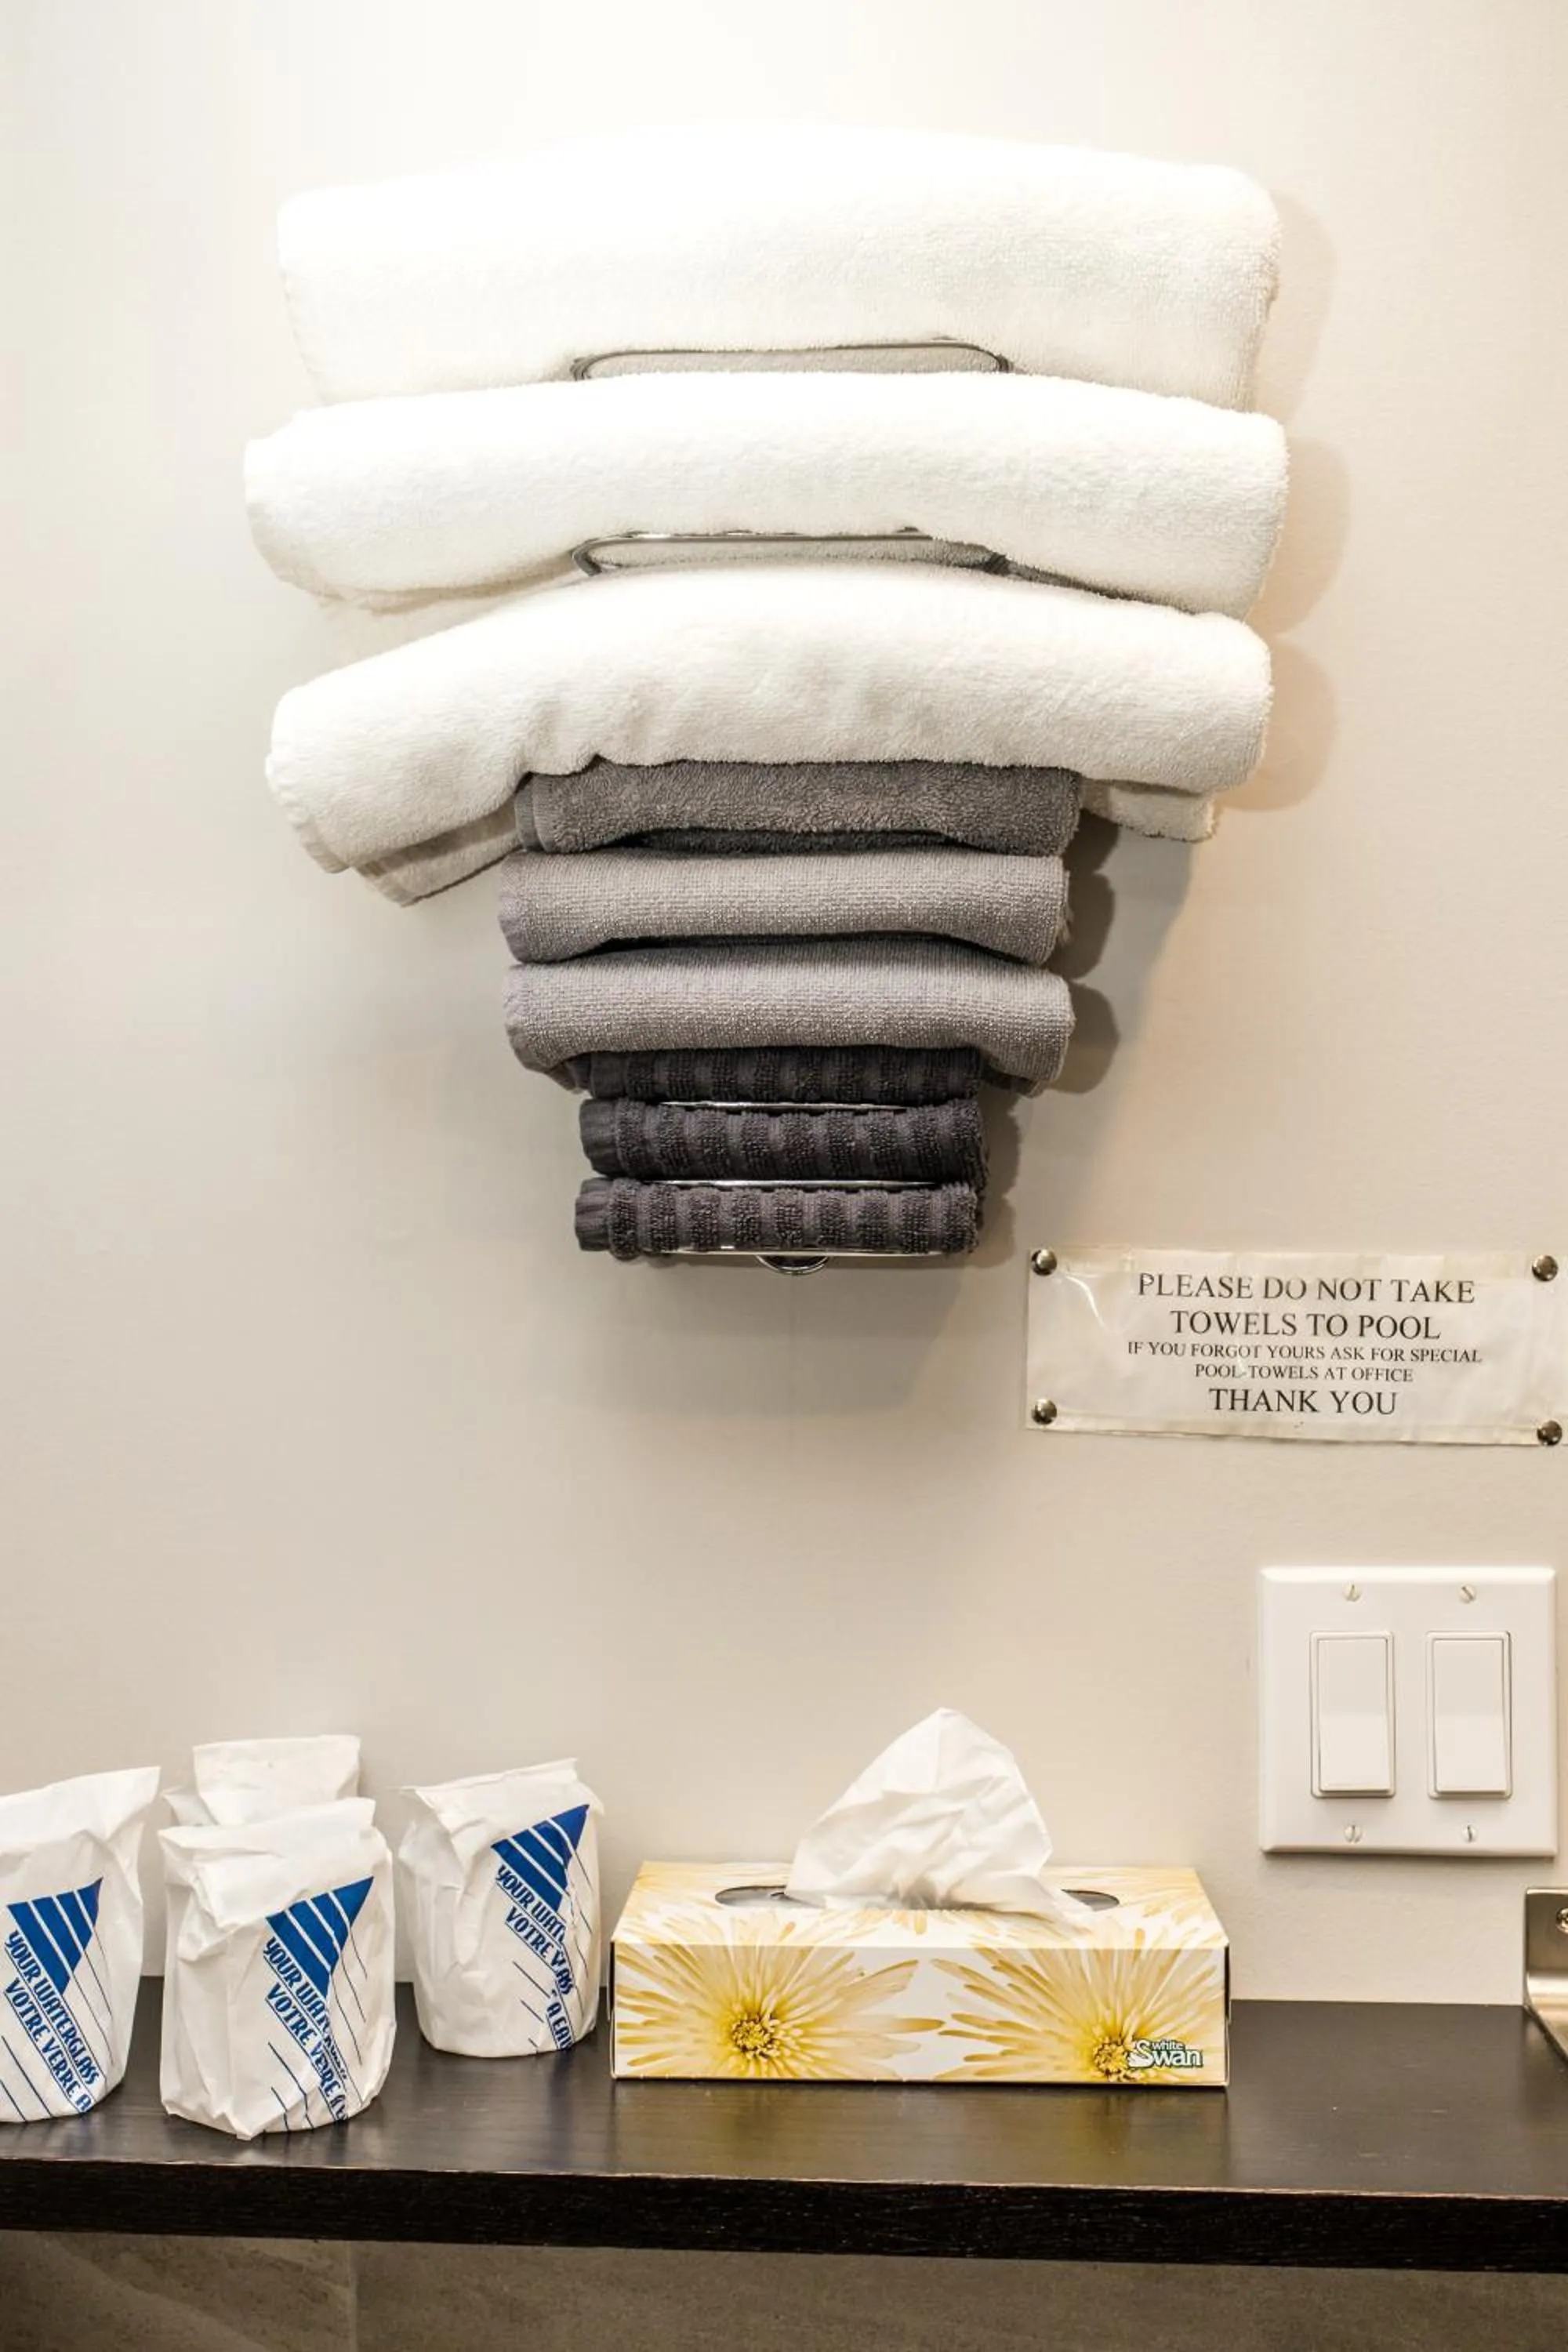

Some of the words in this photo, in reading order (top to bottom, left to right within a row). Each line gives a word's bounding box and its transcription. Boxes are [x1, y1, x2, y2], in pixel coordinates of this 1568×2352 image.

[1138, 1273, 1253, 1299] PLEASE
[1263, 1277, 1308, 1300] DO
[1317, 1279, 1382, 1302] NOT
[1390, 1279, 1475, 1304] TAKE
[1170, 1310, 1298, 1337] TOWELS
[1306, 1313, 1349, 1338] TO
[1358, 1316, 1442, 1340] POOL
[1128, 1341, 1144, 1355] IF
[1148, 1341, 1186, 1356] YOU
[1191, 1343, 1261, 1359] FORGOT
[1267, 1345, 1326, 1359] YOURS
[1330, 1347, 1365, 1361] ASK
[1371, 1348, 1406, 1362] FOR
[1410, 1348, 1483, 1363] SPECIAL
[1195, 1363, 1240, 1378] POOL
[1247, 1365, 1319, 1380] TOWELS
[1324, 1367, 1347, 1381] AT
[1351, 1367, 1414, 1382] OFFICE
[1208, 1388, 1319, 1414] THANK
[1329, 1390, 1397, 1415] YOU
[495, 1864, 535, 1909] YOUR
[506, 1905, 554, 1958] VOTRE
[263, 1936, 303, 1989] YOUR
[5, 1929, 42, 1983] YOUR
[33, 1978, 100, 2085] WATERGLASS
[267, 1981, 318, 2046] VOTRE
[5, 1976, 51, 2042] VOTRE
[41, 2037, 81, 2099] VERRE
[1152, 2040, 1185, 2050] white
[1129, 2039, 1203, 2068] Swan
